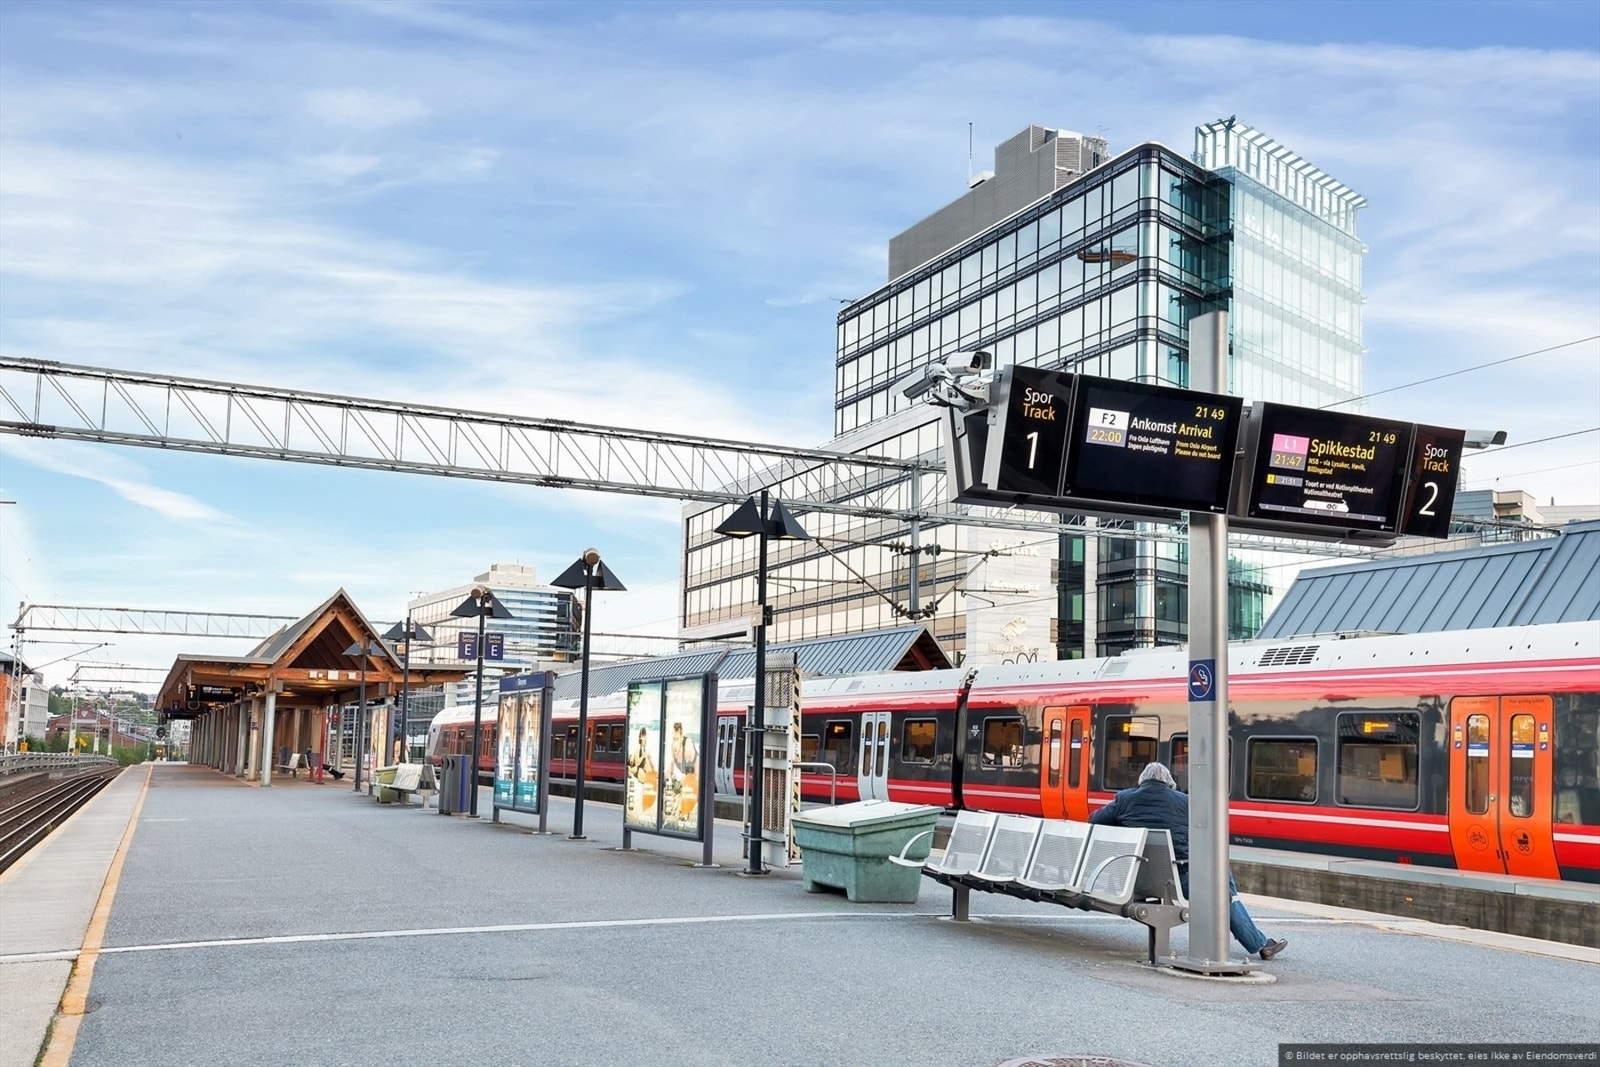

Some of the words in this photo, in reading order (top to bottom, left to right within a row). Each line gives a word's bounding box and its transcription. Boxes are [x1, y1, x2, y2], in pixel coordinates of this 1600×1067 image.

[1024, 387, 1054, 405] Spor
[1023, 403, 1056, 420] Track
[1195, 406, 1208, 418] 21
[1211, 408, 1225, 420] 49
[1101, 413, 1117, 426] F2
[1130, 417, 1177, 434] Ankomst
[1178, 423, 1212, 438] Arrival
[1091, 429, 1122, 443] 22:00
[1129, 434, 1137, 442] Fra
[1138, 435, 1149, 443] Oslo
[1150, 437, 1170, 446] Lufthavn
[1369, 431, 1380, 442] 21
[1383, 433, 1396, 444] 49
[1026, 431, 1039, 469] 1
[1128, 442, 1142, 450] Ingen
[1176, 440, 1189, 448] From
[1201, 444, 1218, 452] Airport
[1284, 439, 1297, 450] L1
[1310, 439, 1375, 460] Spikkestad
[1424, 443, 1448, 459] Spor
[1174, 448, 1192, 456] Please
[1207, 452, 1221, 460] board
[1274, 453, 1302, 467] 21:47
[1423, 457, 1450, 473] Track
[1419, 481, 1439, 516] 2
[464, 644, 472, 656] E
[491, 645, 498, 656] E
